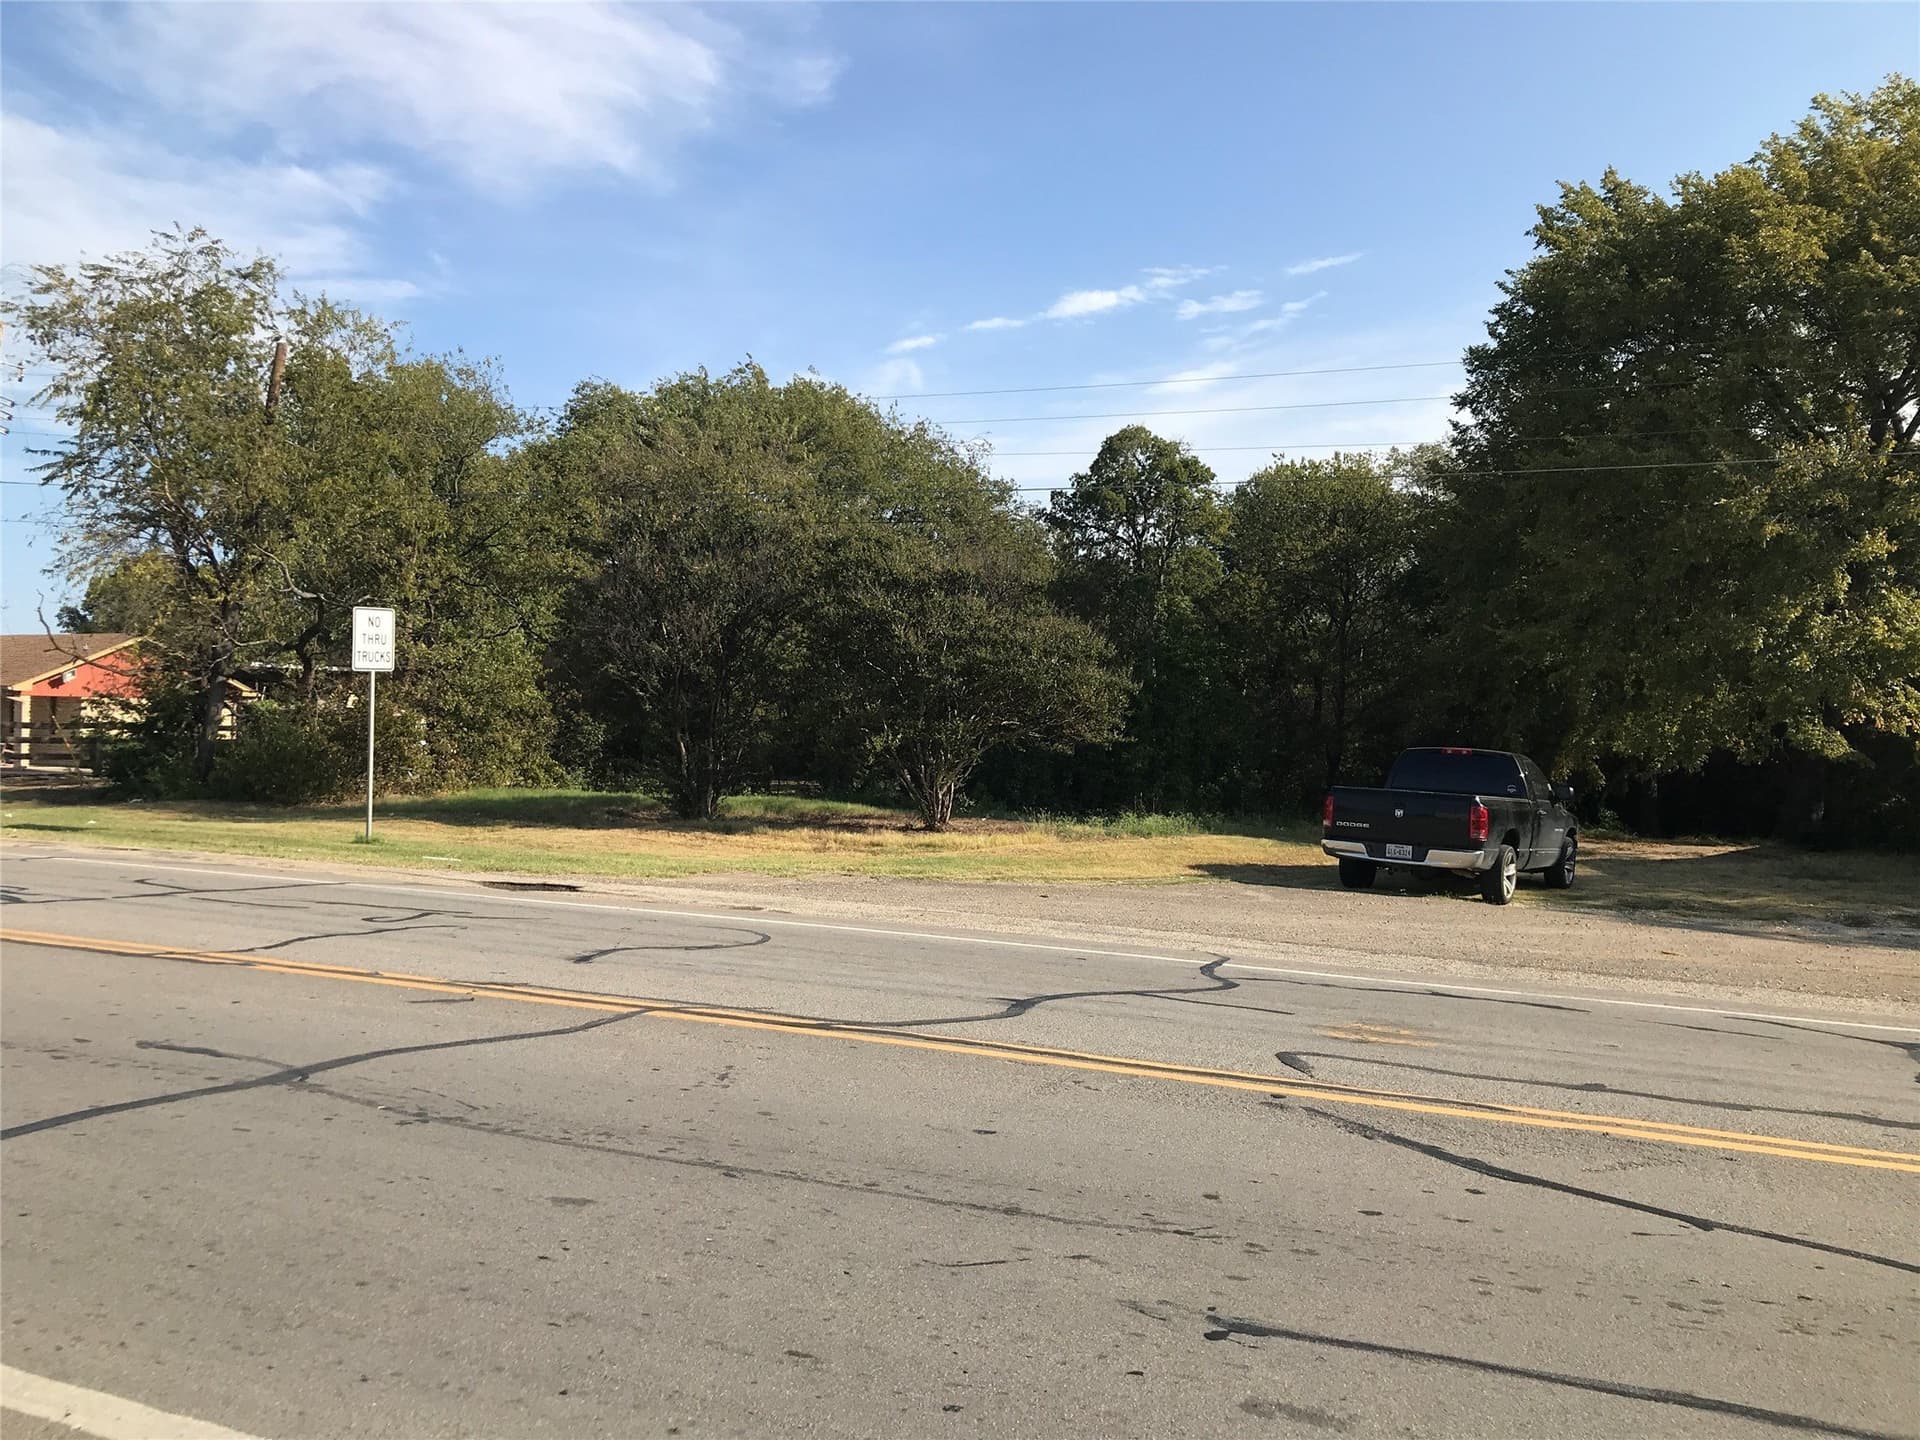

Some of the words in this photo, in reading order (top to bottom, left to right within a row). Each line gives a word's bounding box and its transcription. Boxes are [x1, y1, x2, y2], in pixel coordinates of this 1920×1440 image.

[368, 616, 380, 628] NO
[362, 633, 387, 645] THRU
[357, 650, 391, 663] TRUCKS
